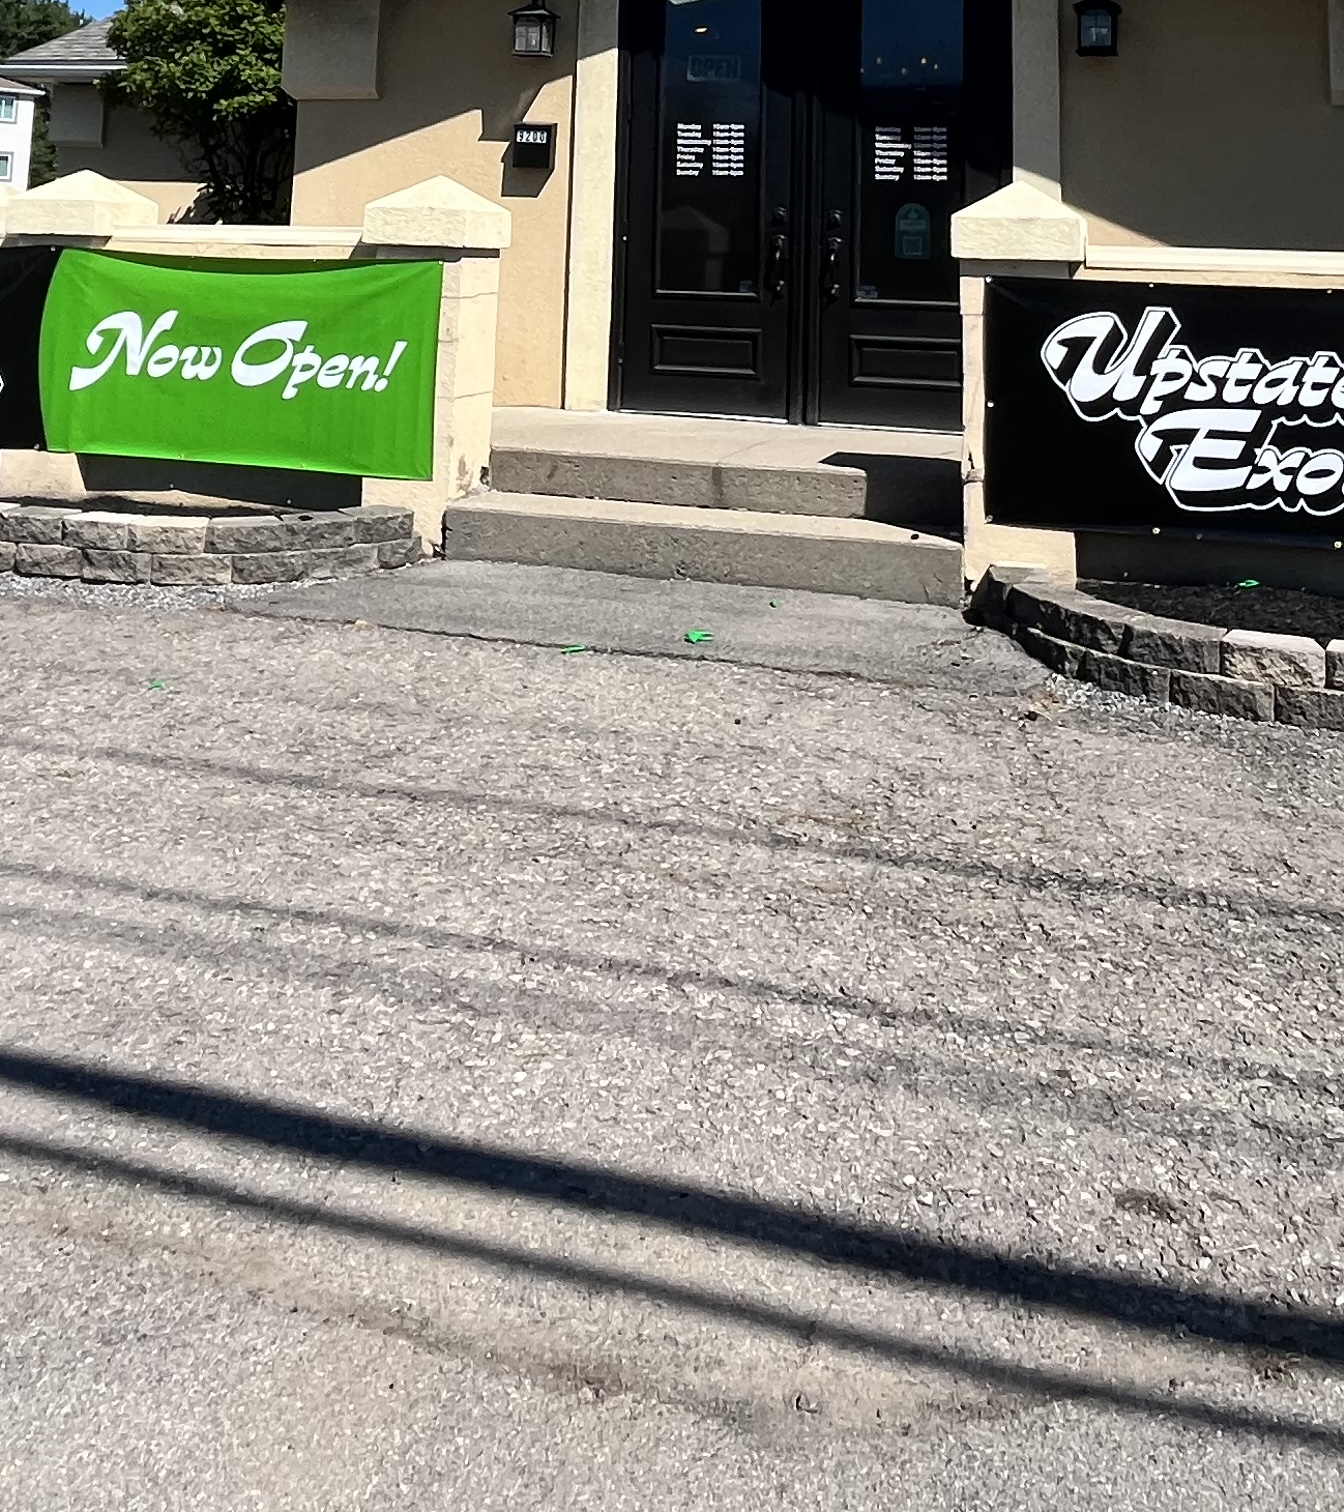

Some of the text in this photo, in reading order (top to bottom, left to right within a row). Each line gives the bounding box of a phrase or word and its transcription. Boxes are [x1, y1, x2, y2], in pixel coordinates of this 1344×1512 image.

[518, 129, 545, 142] 9200
[69, 310, 408, 400] Now Open!
